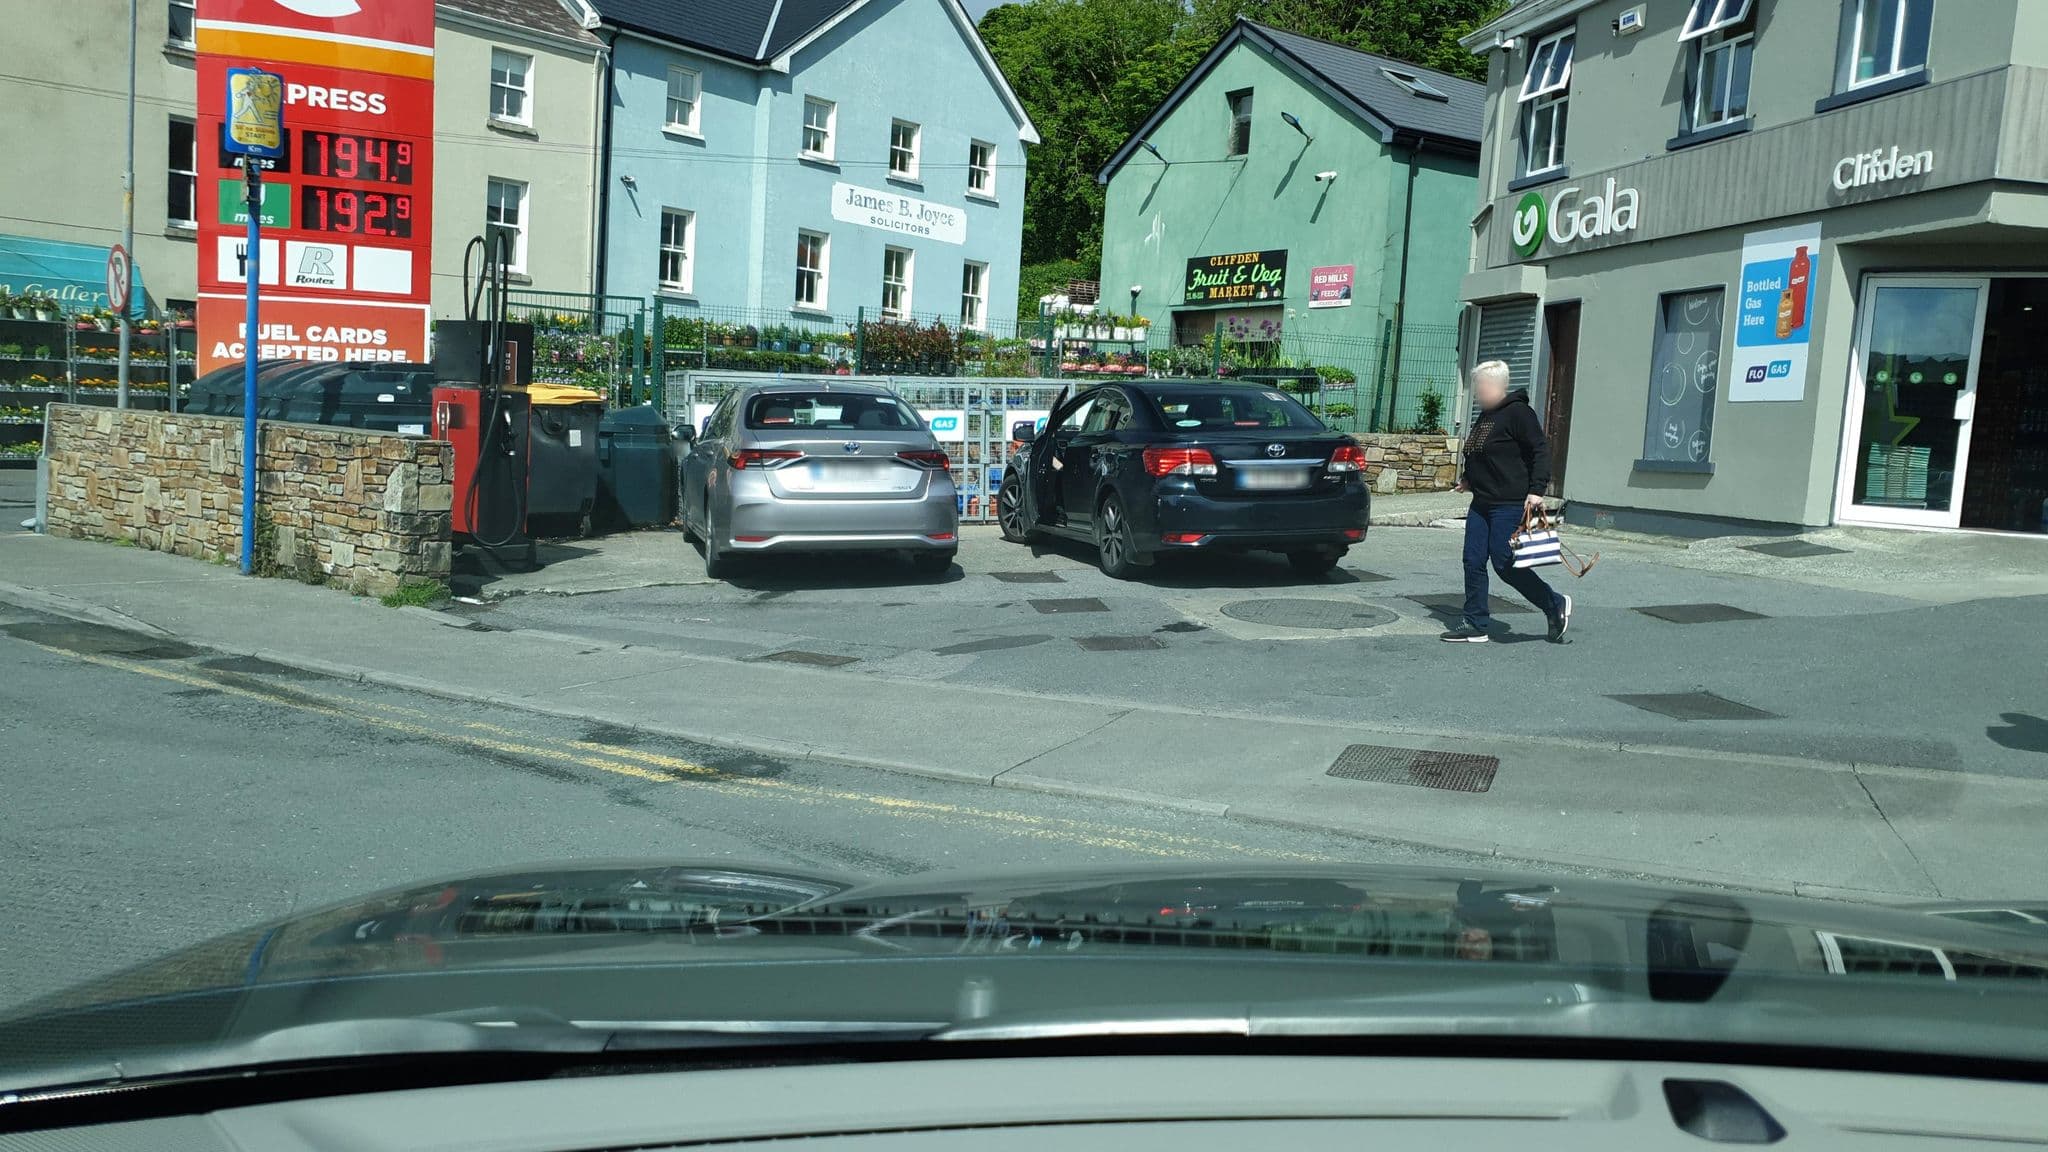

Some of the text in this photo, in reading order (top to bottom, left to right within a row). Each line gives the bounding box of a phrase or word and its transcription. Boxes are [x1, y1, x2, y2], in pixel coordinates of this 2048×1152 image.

[283, 83, 386, 114] PRESS
[1833, 146, 1933, 190] Clifden
[846, 188, 955, 226] James B. Joyce
[1548, 177, 1639, 243] Gala
[234, 212, 275, 225] mes
[870, 216, 930, 235] SOLICITORS
[1210, 252, 1260, 267] CLIFDEN
[296, 275, 335, 285] Routex
[1188, 263, 1282, 290] Fruit & Veg
[1314, 273, 1348, 284] RED MILLS
[1746, 277, 1781, 292] Bottled
[25, 283, 108, 302] Galler
[1209, 284, 1256, 299] MARKET
[1745, 297, 1762, 309] Gas
[1743, 314, 1765, 326] Here
[306, 326, 387, 345] CARDS
[212, 342, 339, 362] ACEPTED
[1748, 364, 1788, 380] FLO GAS
[934, 420, 953, 428] GAS
